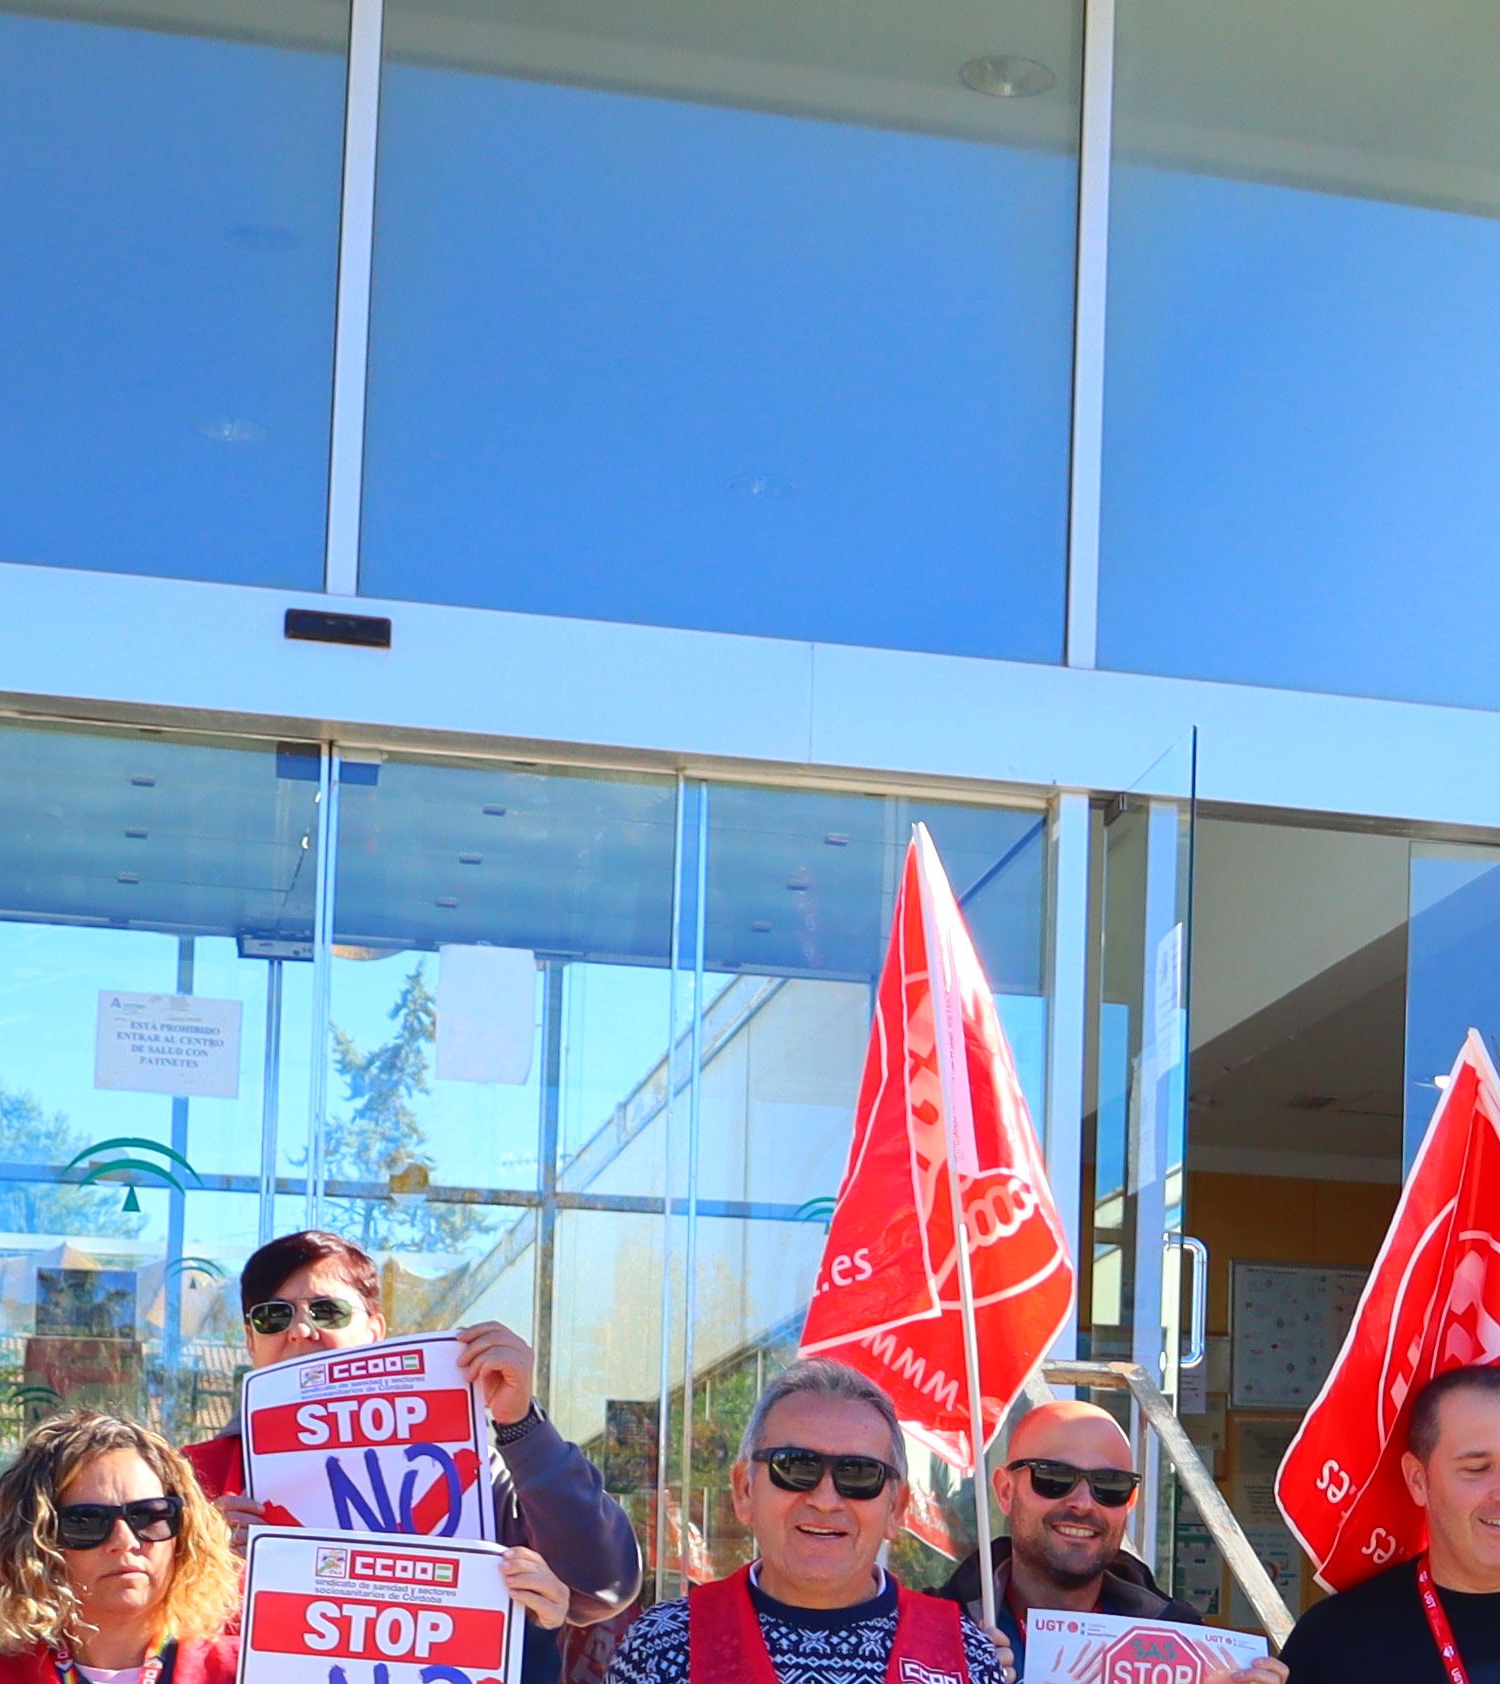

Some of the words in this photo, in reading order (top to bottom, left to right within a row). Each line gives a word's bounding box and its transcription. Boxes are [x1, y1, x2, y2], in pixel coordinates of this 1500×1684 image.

[130, 1018, 158, 1032] ESTÁ
[160, 1023, 221, 1036] PROHIBIDO
[116, 1031, 161, 1043] ENTRAR
[163, 1036, 177, 1044] AL
[179, 1036, 224, 1048] CENTRO
[131, 1043, 146, 1053] DE
[147, 1045, 184, 1056] SALUD
[185, 1048, 209, 1058] CON
[139, 1055, 199, 1069] PATINETES
[296, 1396, 428, 1446] STOP
[325, 1442, 463, 1538] NO
[315, 1579, 357, 1589] sindicato
[359, 1580, 370, 1589] de
[373, 1582, 408, 1592] sanidad
[418, 1588, 457, 1598] sectores
[315, 1586, 385, 1600] sociosanitarios
[388, 1592, 401, 1601] de
[403, 1593, 443, 1604] Córdoba
[303, 1600, 454, 1658] STOP
[1035, 1619, 1065, 1633] UGT
[1205, 1634, 1223, 1644] UGT
[1131, 1639, 1179, 1661] SAS
